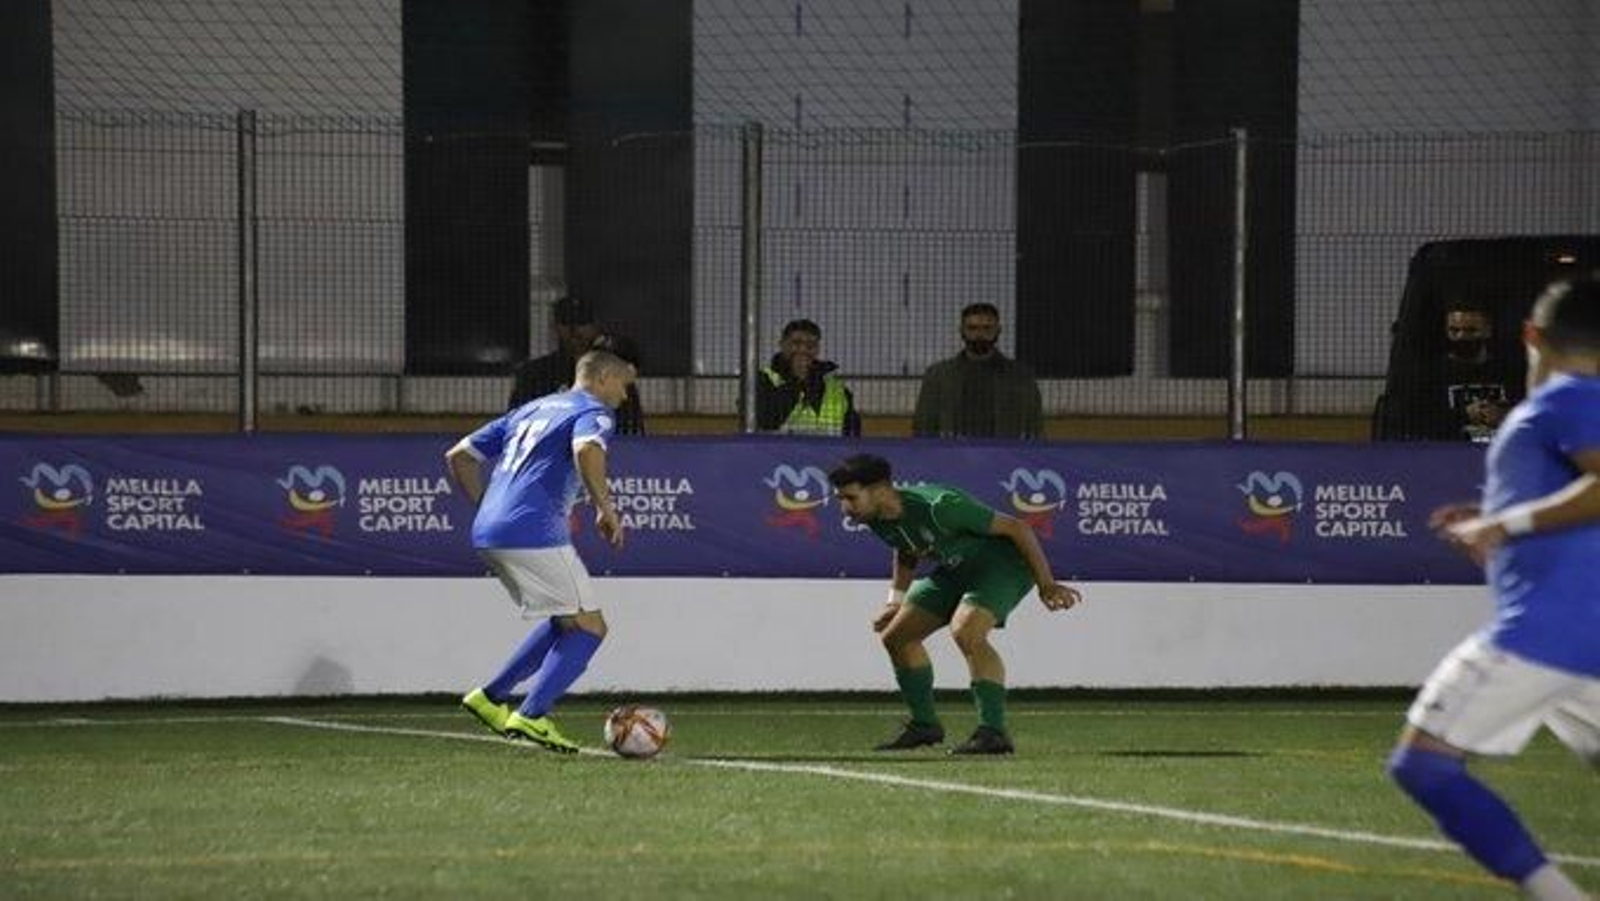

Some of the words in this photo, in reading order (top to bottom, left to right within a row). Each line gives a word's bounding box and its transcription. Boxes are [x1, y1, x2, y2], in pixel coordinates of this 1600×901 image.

[106, 478, 202, 495] MELILLA
[359, 478, 451, 494] MELILLA
[606, 478, 694, 494] MELILLA
[1078, 483, 1167, 501] MELILLA
[1315, 485, 1405, 501] MELILLA
[107, 495, 186, 512] SPORT
[360, 496, 435, 513] SPORT
[1079, 501, 1151, 518] SPORT
[1316, 503, 1388, 519] SPORT
[107, 514, 205, 530] CAPITAL
[360, 514, 453, 531] CAPITAL
[621, 514, 696, 529] APITAL
[1079, 519, 1169, 536] CAPITAL
[1316, 520, 1407, 537] CAPITAL
